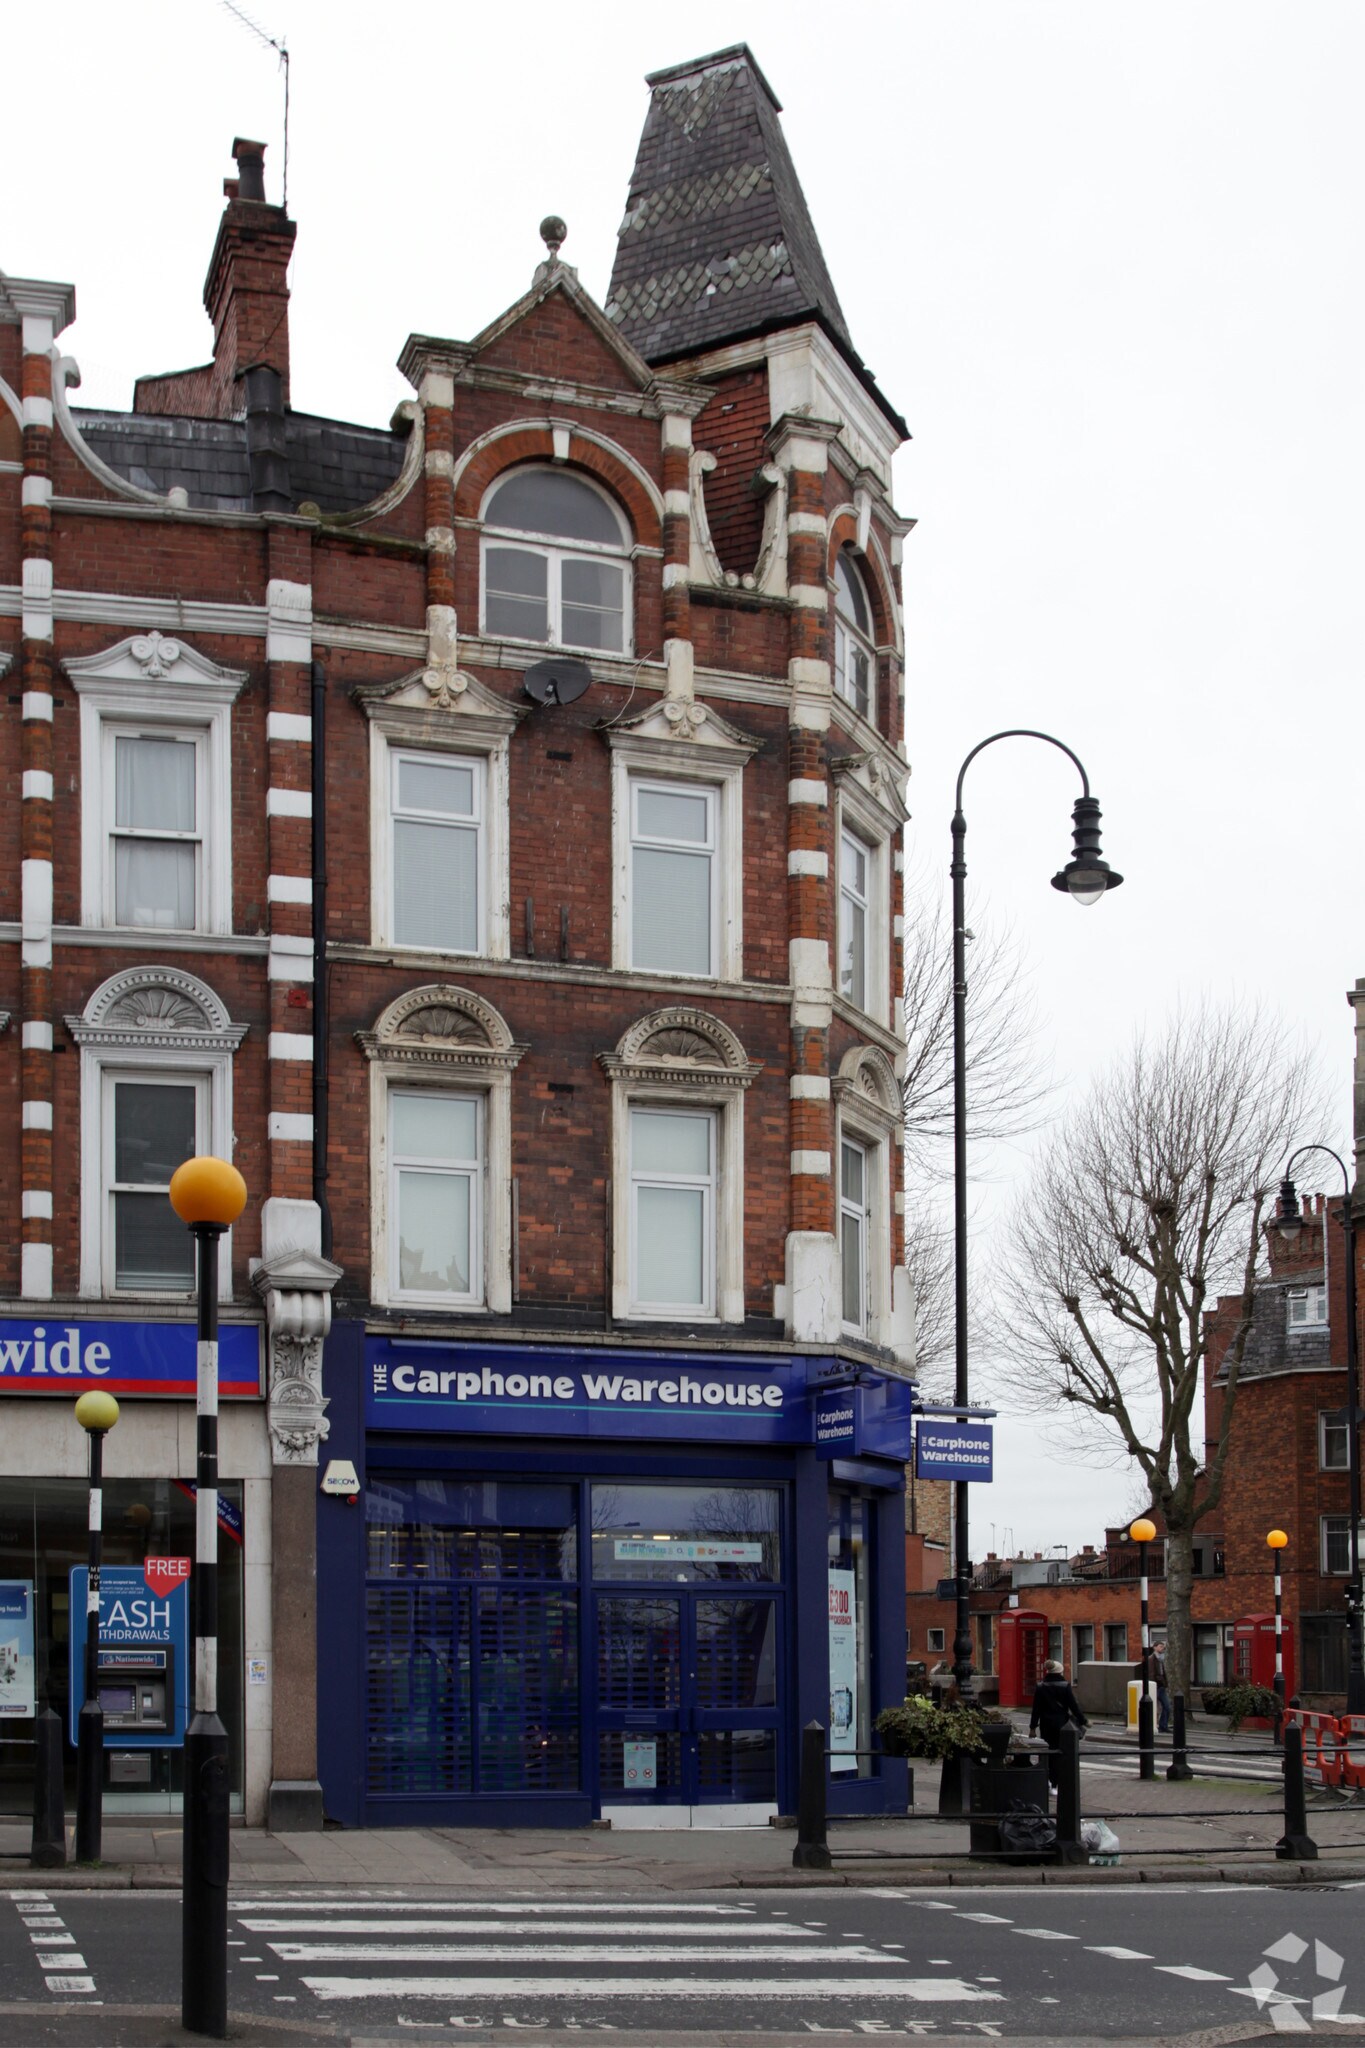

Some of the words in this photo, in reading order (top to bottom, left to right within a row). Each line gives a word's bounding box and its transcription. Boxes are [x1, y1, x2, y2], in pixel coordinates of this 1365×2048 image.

[0, 1327, 111, 1375] wide
[373, 1364, 387, 1393] THE
[391, 1365, 575, 1400] Carphone
[581, 1373, 784, 1407] Warehouse
[820, 1408, 854, 1426] Carphone
[817, 1424, 854, 1440] Warehouse
[927, 1436, 990, 1450] Carphone
[921, 1450, 990, 1464] Warehouse
[147, 1559, 188, 1577] FREE
[829, 1589, 849, 1614] £300
[99, 1629, 170, 1641] ITHDRAWALS
[115, 1655, 153, 1663] Nationwide
